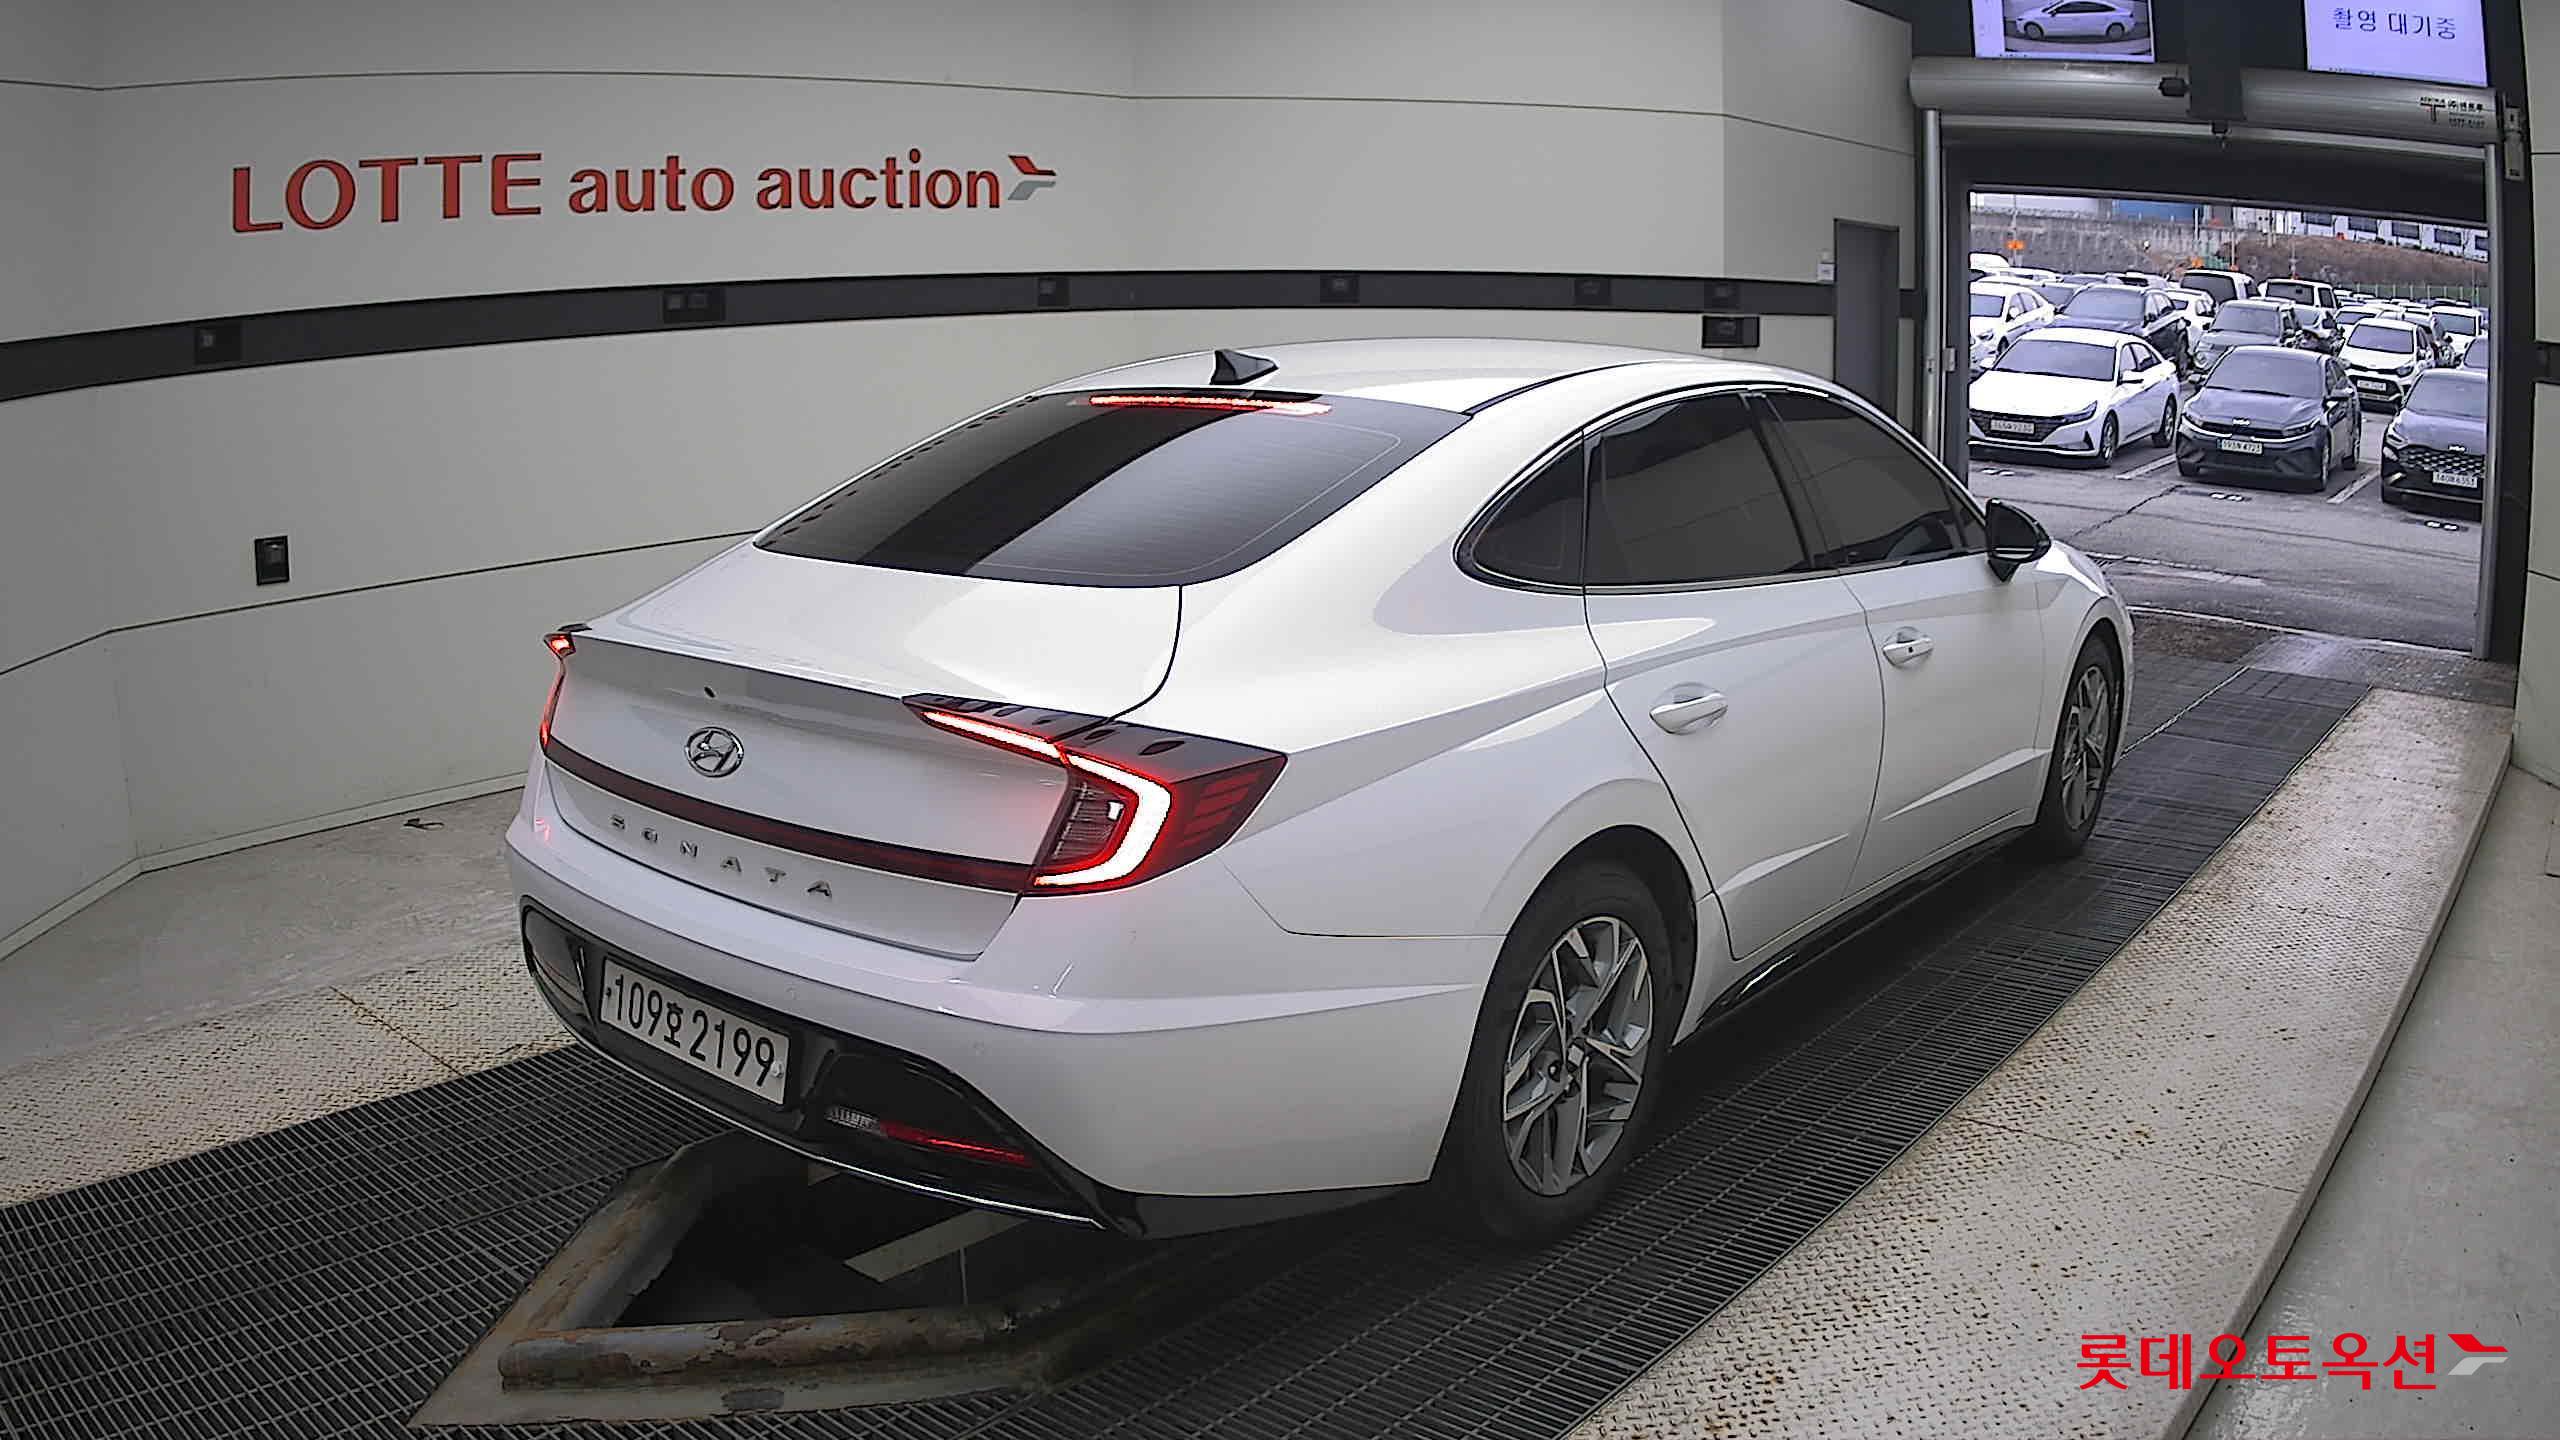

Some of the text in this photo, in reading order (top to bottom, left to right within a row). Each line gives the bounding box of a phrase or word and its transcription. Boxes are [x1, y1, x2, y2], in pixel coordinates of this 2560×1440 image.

[2333, 8, 2456, 40] 촬영 대기중
[232, 148, 1001, 233] LOTTE auto auction
[609, 813, 833, 898] SONATA
[614, 973, 776, 1088] 109호2199
